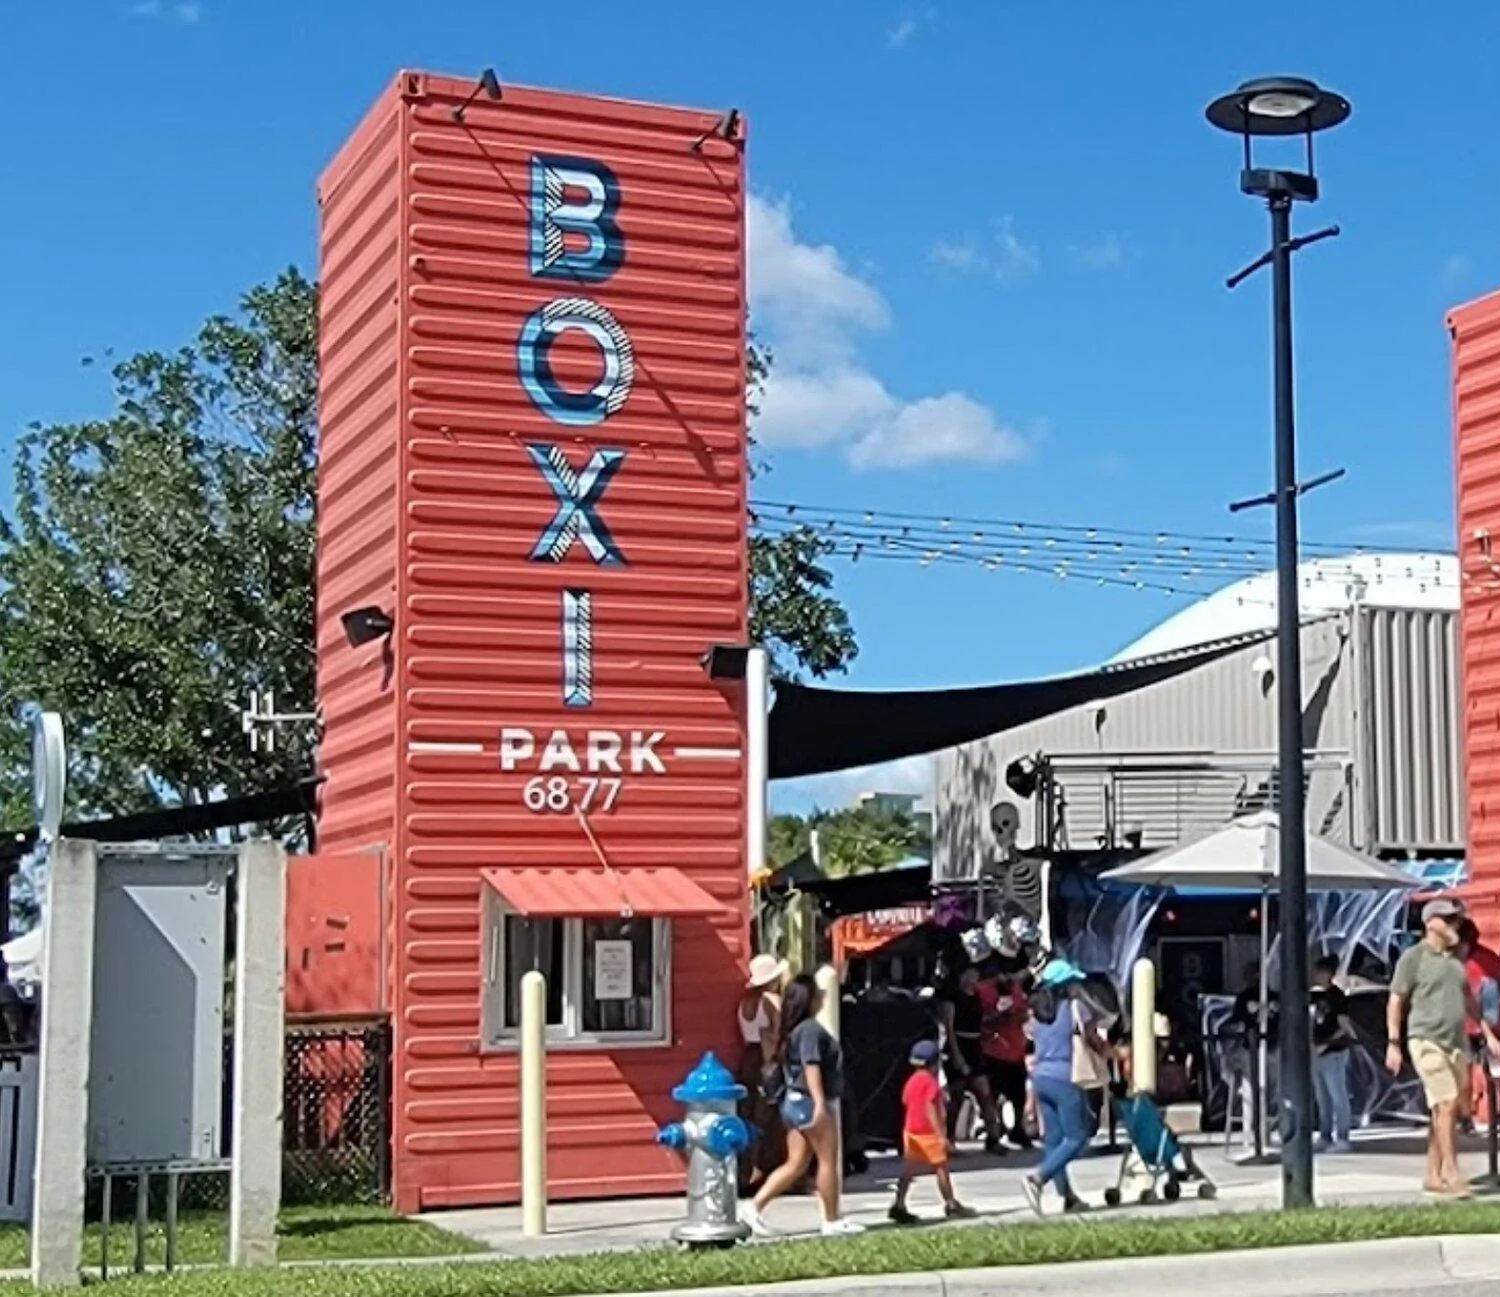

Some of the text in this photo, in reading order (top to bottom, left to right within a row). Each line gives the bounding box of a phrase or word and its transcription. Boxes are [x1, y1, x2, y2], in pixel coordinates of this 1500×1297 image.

[516, 154, 637, 707] BOXI
[500, 728, 667, 773] PARK
[523, 777, 622, 811] 6877
